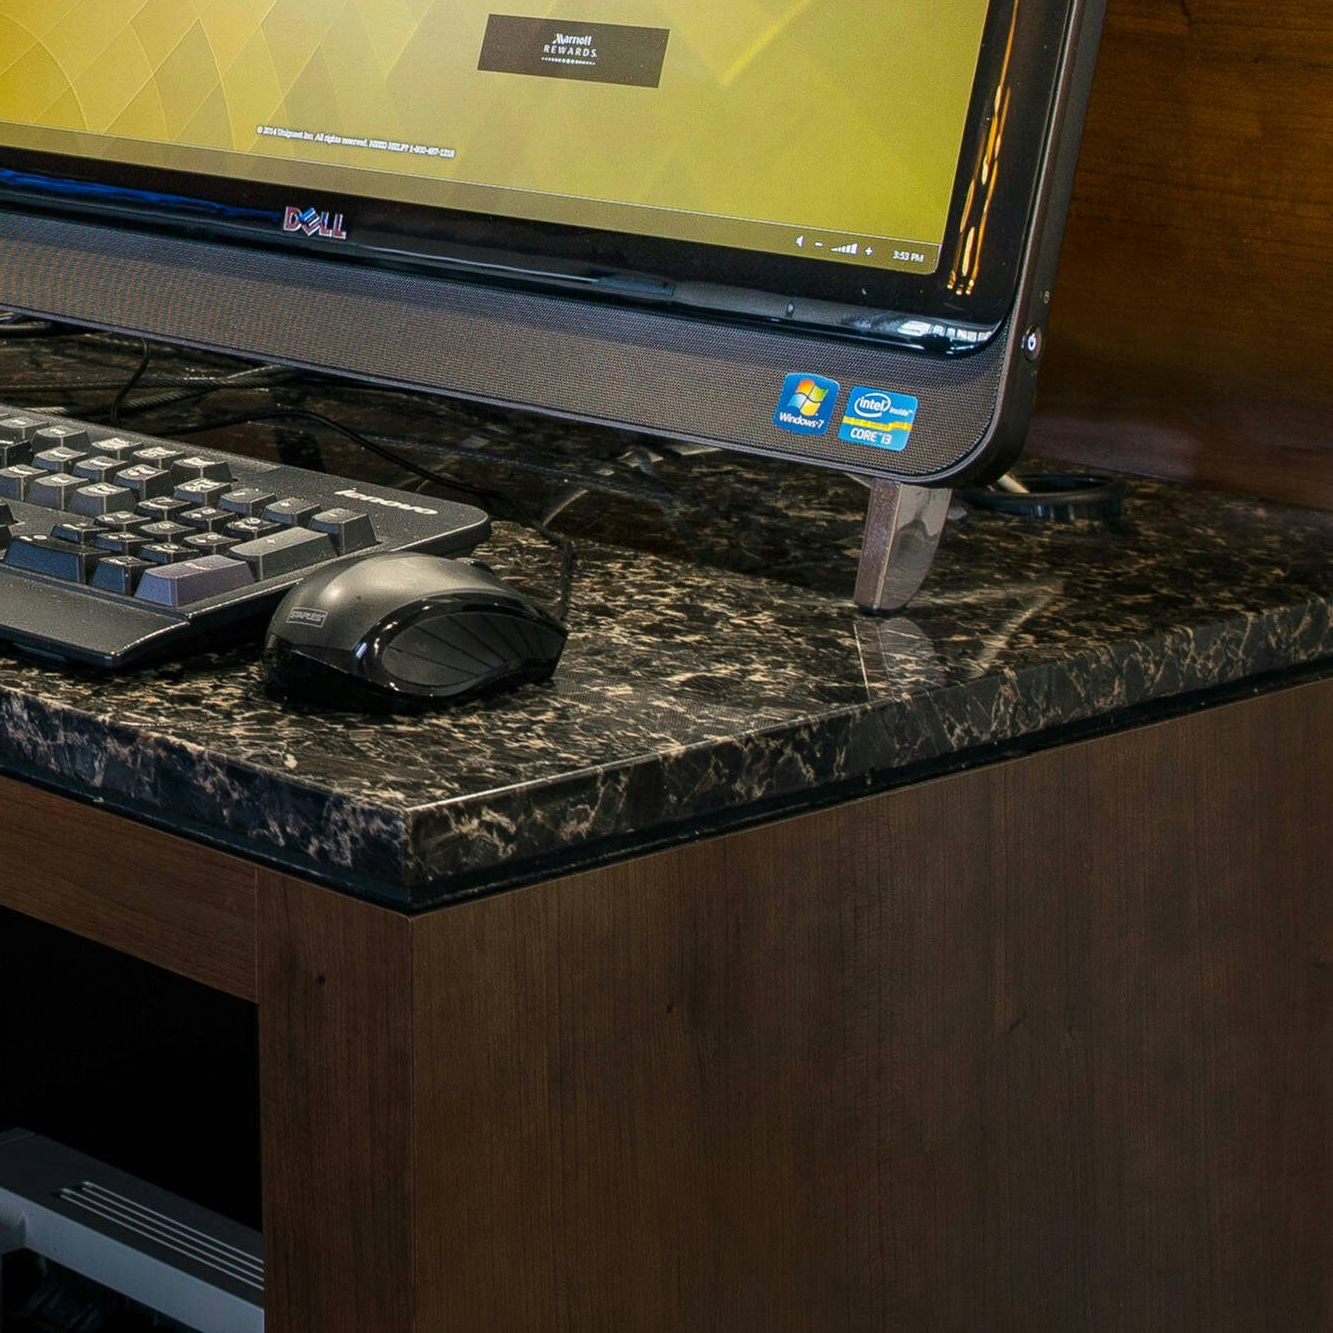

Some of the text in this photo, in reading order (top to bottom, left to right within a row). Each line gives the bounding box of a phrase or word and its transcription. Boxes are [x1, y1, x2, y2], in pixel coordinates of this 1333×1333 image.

[283, 206, 347, 240] DELL
[910, 252, 925, 263] PM
[859, 396, 887, 411] intel
[779, 412, 818, 428] Windows
[850, 428, 878, 442] CORE
